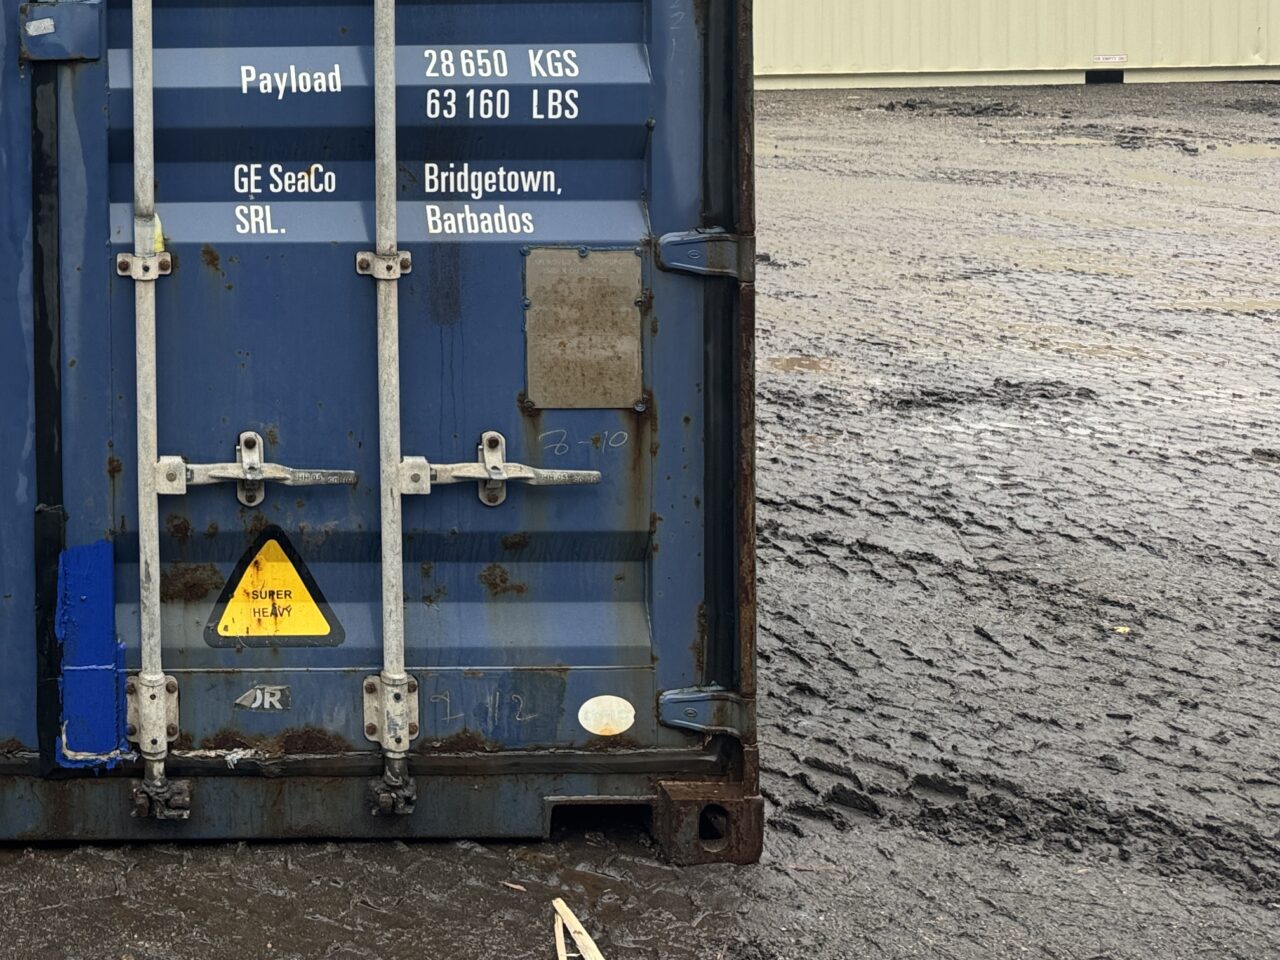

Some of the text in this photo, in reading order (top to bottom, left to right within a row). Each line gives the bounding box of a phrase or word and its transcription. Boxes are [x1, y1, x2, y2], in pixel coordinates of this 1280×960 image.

[528, 49, 579, 77] KGS
[240, 63, 342, 100] Payload
[532, 88, 579, 119] LBS
[233, 163, 336, 194] GE SeaCo
[424, 162, 562, 200] Bridgetown,
[235, 205, 286, 234] SRL.
[425, 204, 534, 235] Barbados
[251, 589, 292, 600] SUPER
[252, 607, 292, 618] HEAVY
